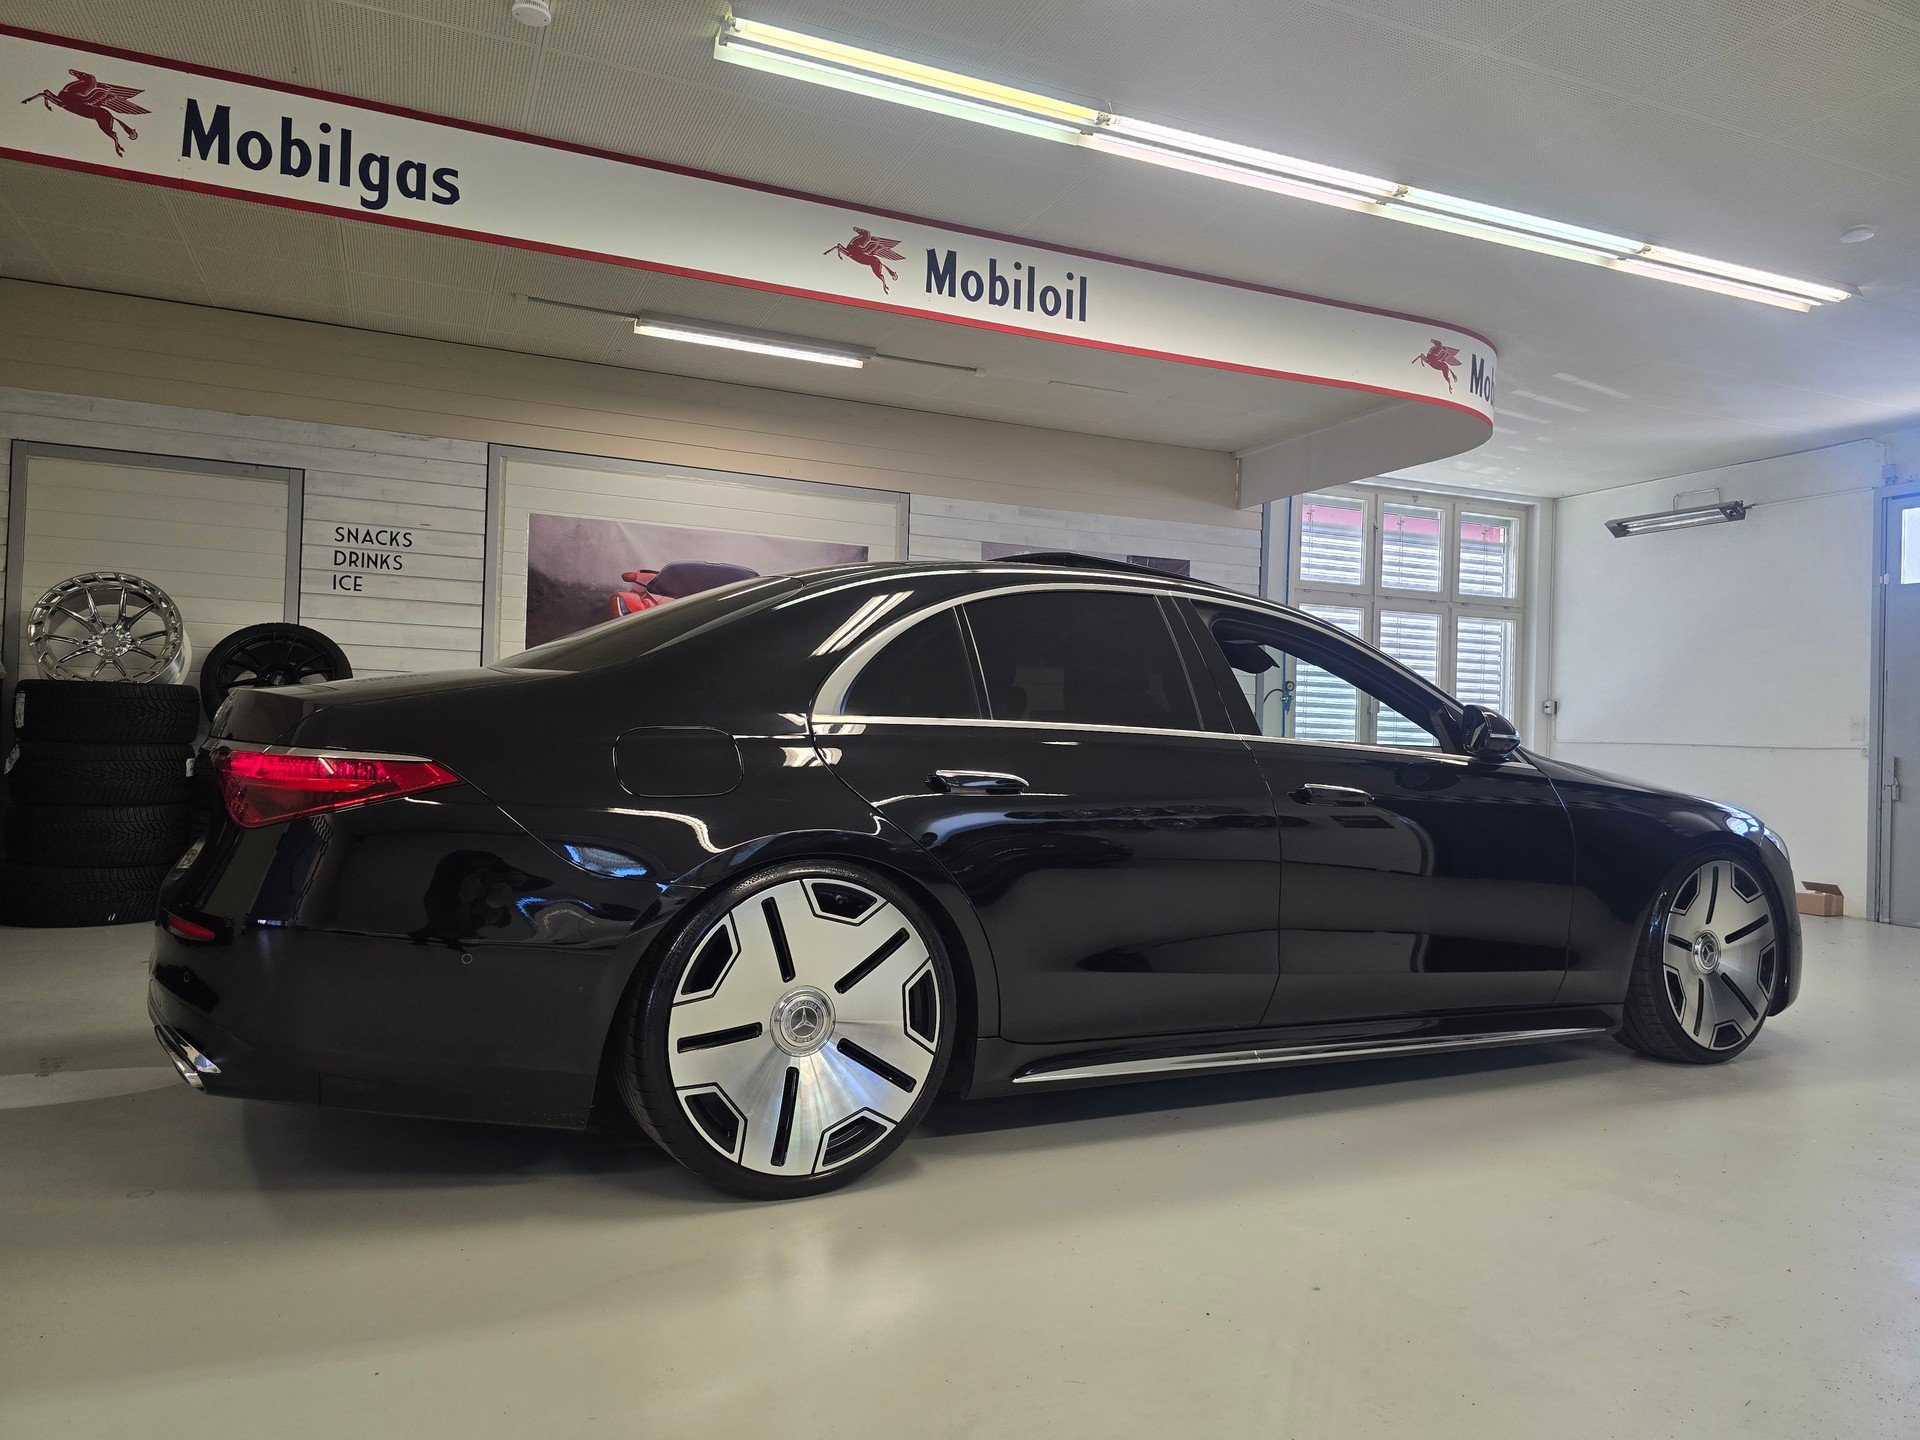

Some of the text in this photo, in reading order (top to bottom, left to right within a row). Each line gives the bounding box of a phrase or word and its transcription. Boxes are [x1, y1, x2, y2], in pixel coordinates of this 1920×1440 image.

[181, 97, 460, 210] Mobilgas
[925, 248, 1087, 322] Mobiloil
[334, 526, 413, 547] SNACKS
[333, 549, 403, 571] DRINKS
[332, 574, 363, 592] ICE
[790, 1000, 818, 1011] MERCEDES
